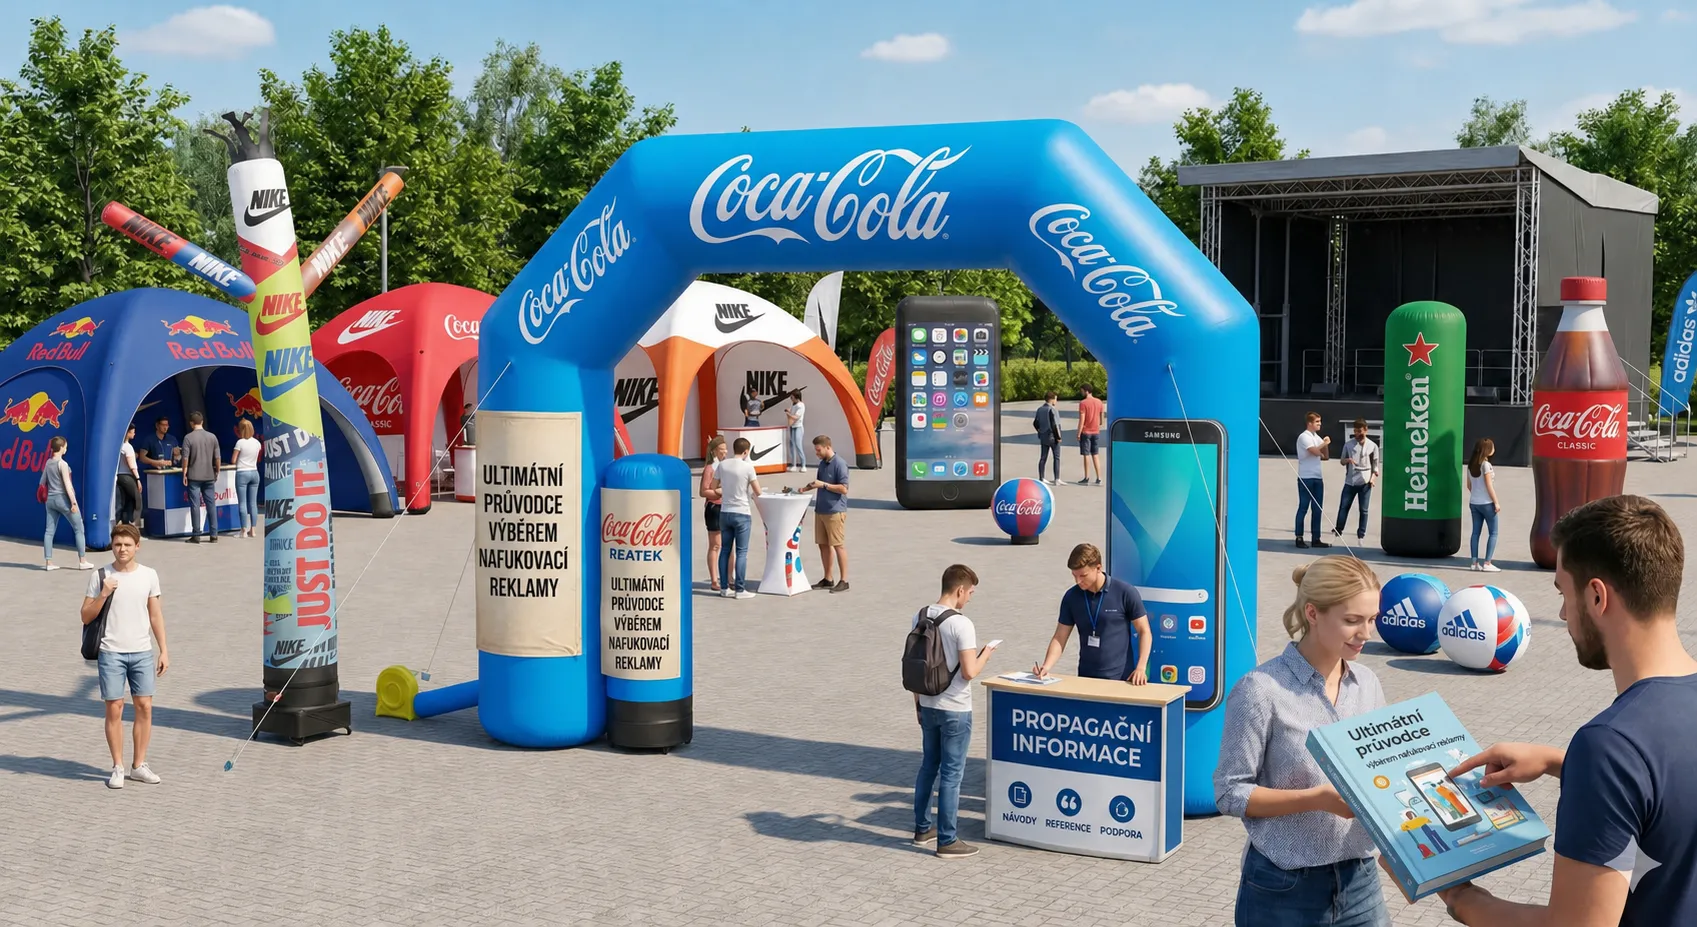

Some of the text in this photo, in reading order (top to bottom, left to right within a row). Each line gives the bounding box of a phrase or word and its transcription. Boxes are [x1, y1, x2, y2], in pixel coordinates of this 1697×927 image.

[249, 188, 287, 209] NIKE
[357, 183, 391, 229] NIKE
[121, 215, 177, 251] NIKE
[309, 231, 349, 278] NIKE
[187, 251, 238, 287] NIKE
[262, 292, 303, 317] NIKE
[715, 303, 750, 319] NIKE
[353, 309, 402, 328] NIKE
[443, 313, 481, 341] Coca
[26, 341, 92, 361] Red Bull
[166, 341, 216, 360] Red
[263, 345, 315, 377] NIKE
[1673, 319, 1696, 383] adidas
[614, 377, 659, 407] NIKE
[746, 370, 788, 396] NIKE
[1534, 403, 1623, 439] Coca-Cola
[1144, 431, 1181, 439] SAMSUNG
[1404, 375, 1430, 512] Heineken
[1557, 441, 1596, 450] CLASSIC
[16, 439, 54, 473] Bul
[294, 461, 326, 497] IT.
[483, 462, 564, 487] ULTIMÁTNÍ
[484, 490, 563, 515] PRŮVODCE
[294, 502, 329, 551] DO
[489, 518, 558, 542] VÝBĚREM
[602, 513, 676, 546] Coca-Cola
[479, 546, 568, 570] NAFUKOVACÍ
[609, 548, 663, 562] REATEK
[295, 556, 332, 631] JUST
[490, 577, 559, 598] REKLAMY
[611, 575, 665, 592] ULTIMÁTNÍ
[1382, 614, 1426, 629] adidas
[1441, 625, 1486, 641] adidas
[274, 639, 306, 655] NIKE
[608, 633, 669, 650] NAFUKOVACÍ
[615, 656, 662, 670] REKLAMY
[1012, 708, 1153, 743] PROPAGAČNÍ
[1347, 708, 1424, 741] Ultimátní
[1013, 733, 1142, 767] INFORMACE
[1002, 811, 1037, 825] NÁVODY
[1045, 818, 1092, 833] REFERENCE
[1100, 826, 1143, 839] PODPORA
